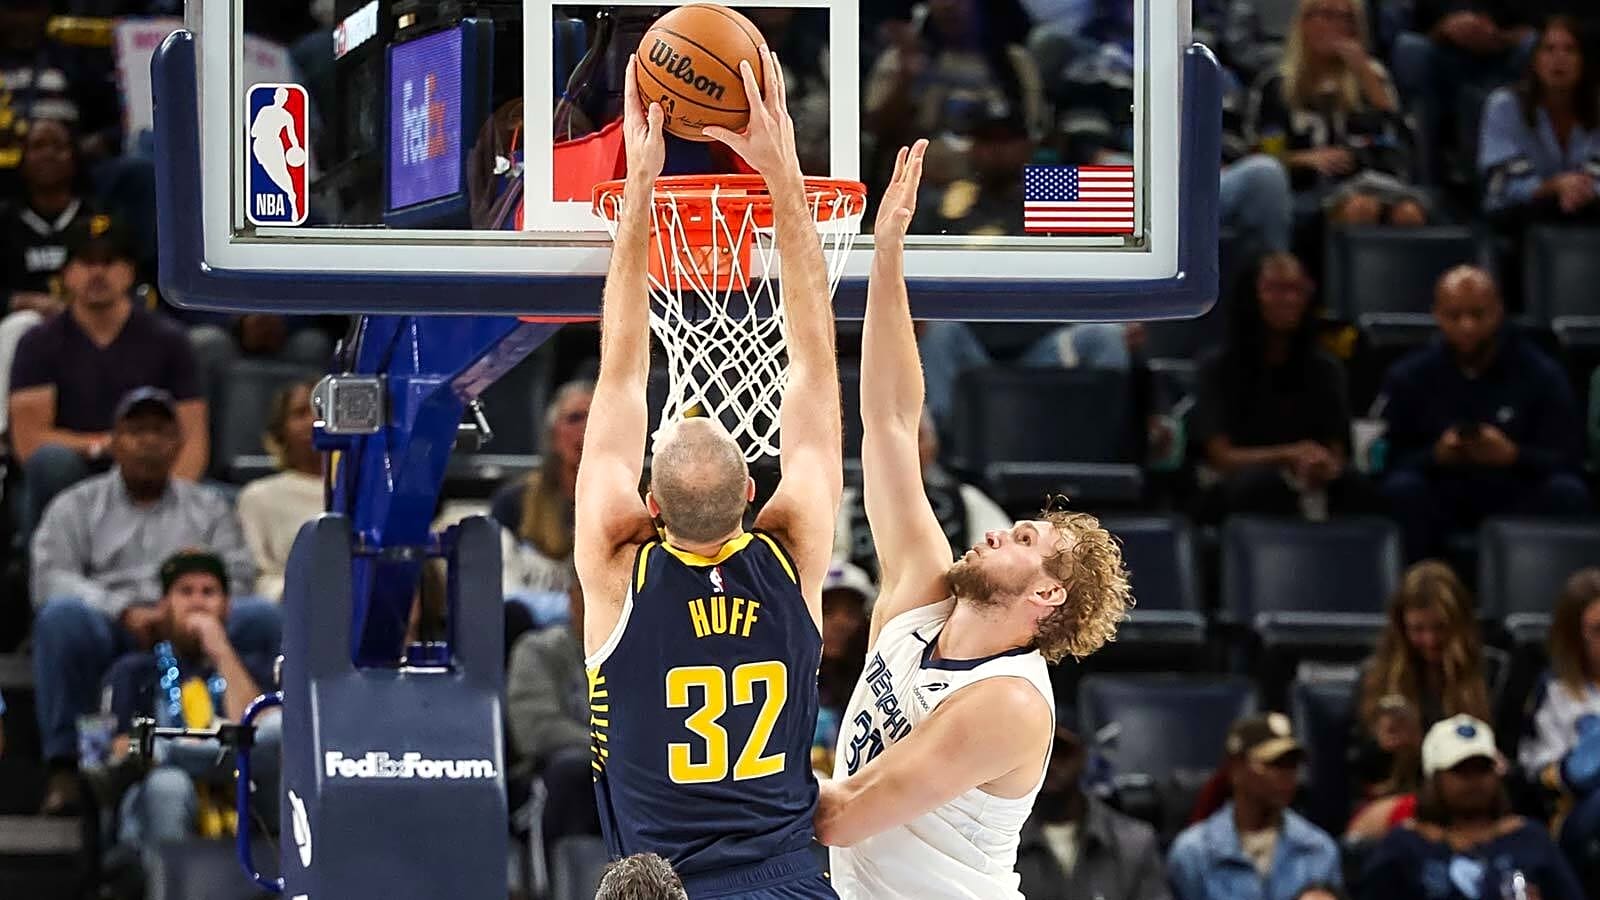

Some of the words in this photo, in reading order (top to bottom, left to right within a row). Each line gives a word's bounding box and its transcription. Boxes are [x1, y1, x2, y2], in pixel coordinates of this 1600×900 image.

[649, 39, 726, 101] Wilson
[256, 193, 286, 217] NBA
[688, 596, 760, 638] HUFF
[665, 660, 788, 785] 32
